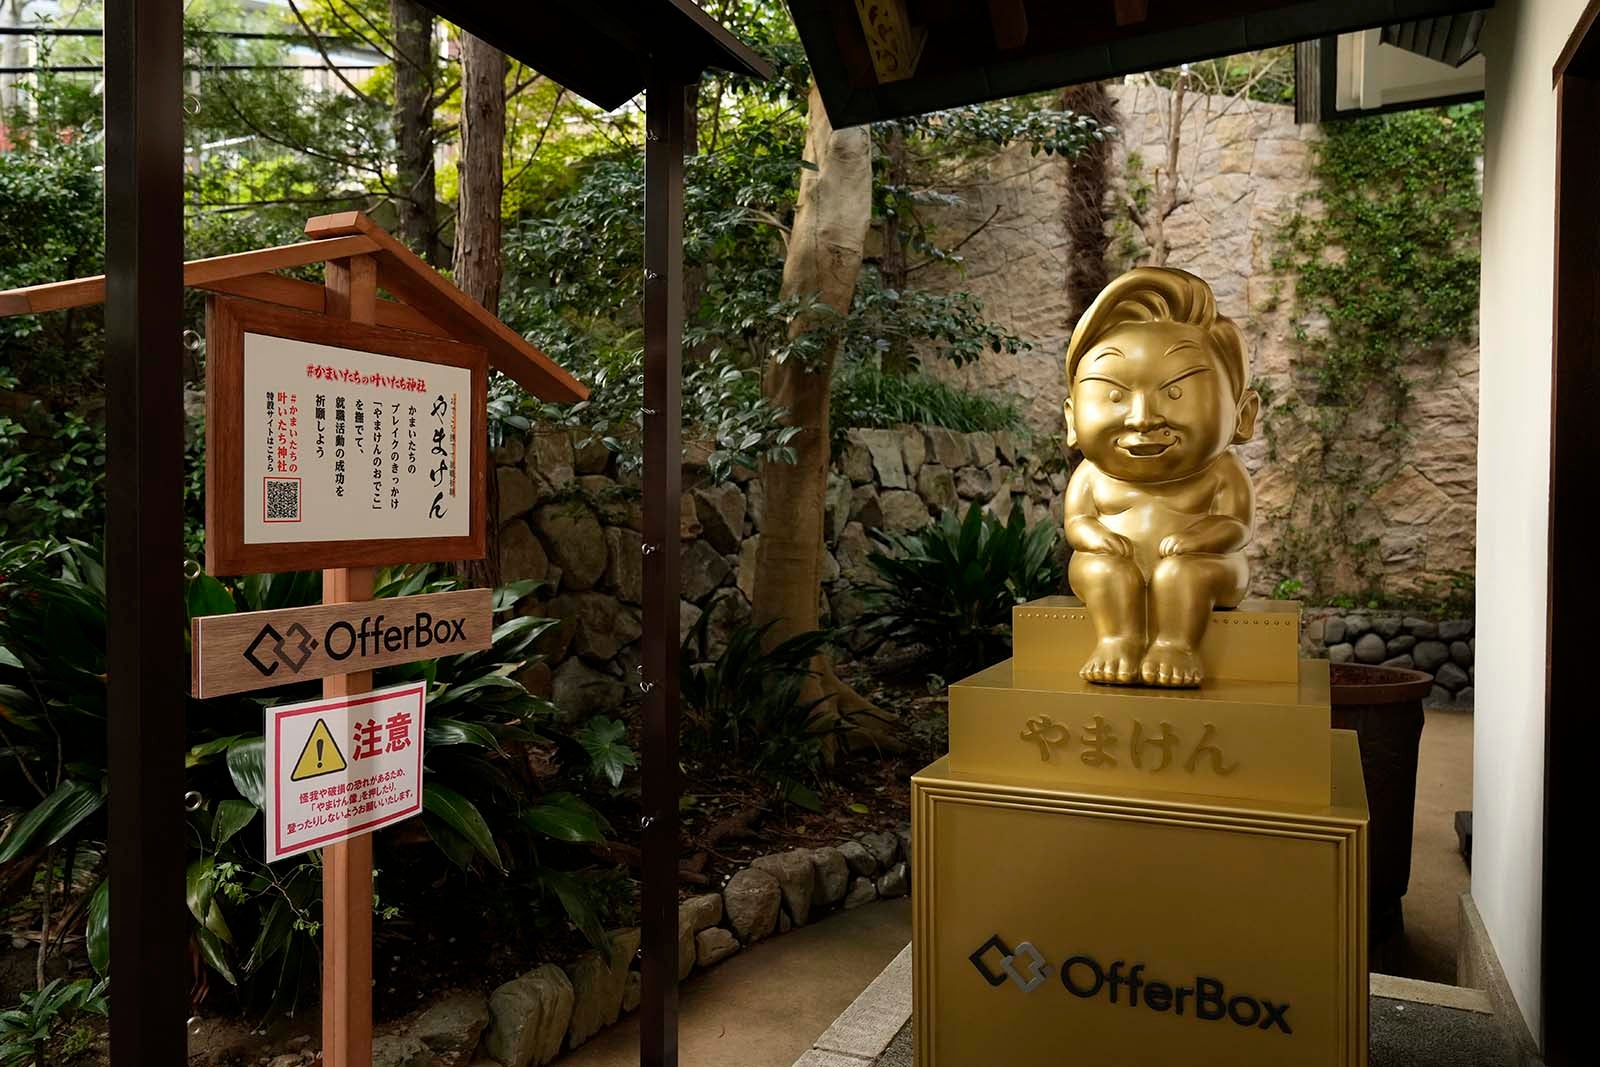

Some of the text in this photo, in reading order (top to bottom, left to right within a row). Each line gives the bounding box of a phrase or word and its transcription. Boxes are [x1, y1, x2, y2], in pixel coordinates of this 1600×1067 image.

[266, 391, 275, 473] 特設サイトはこちら
[277, 392, 288, 473] 叶いたち神社
[315, 394, 326, 459] 祈願しよう
[335, 396, 346, 497] 就職活動の成功を
[408, 405, 416, 474] かまいたちの
[429, 394, 448, 519] やまけん
[324, 612, 466, 661] OfferBox
[352, 712, 412, 761] 注意
[1019, 713, 1240, 776] やまけん
[1060, 955, 1293, 1034] OfferBox
